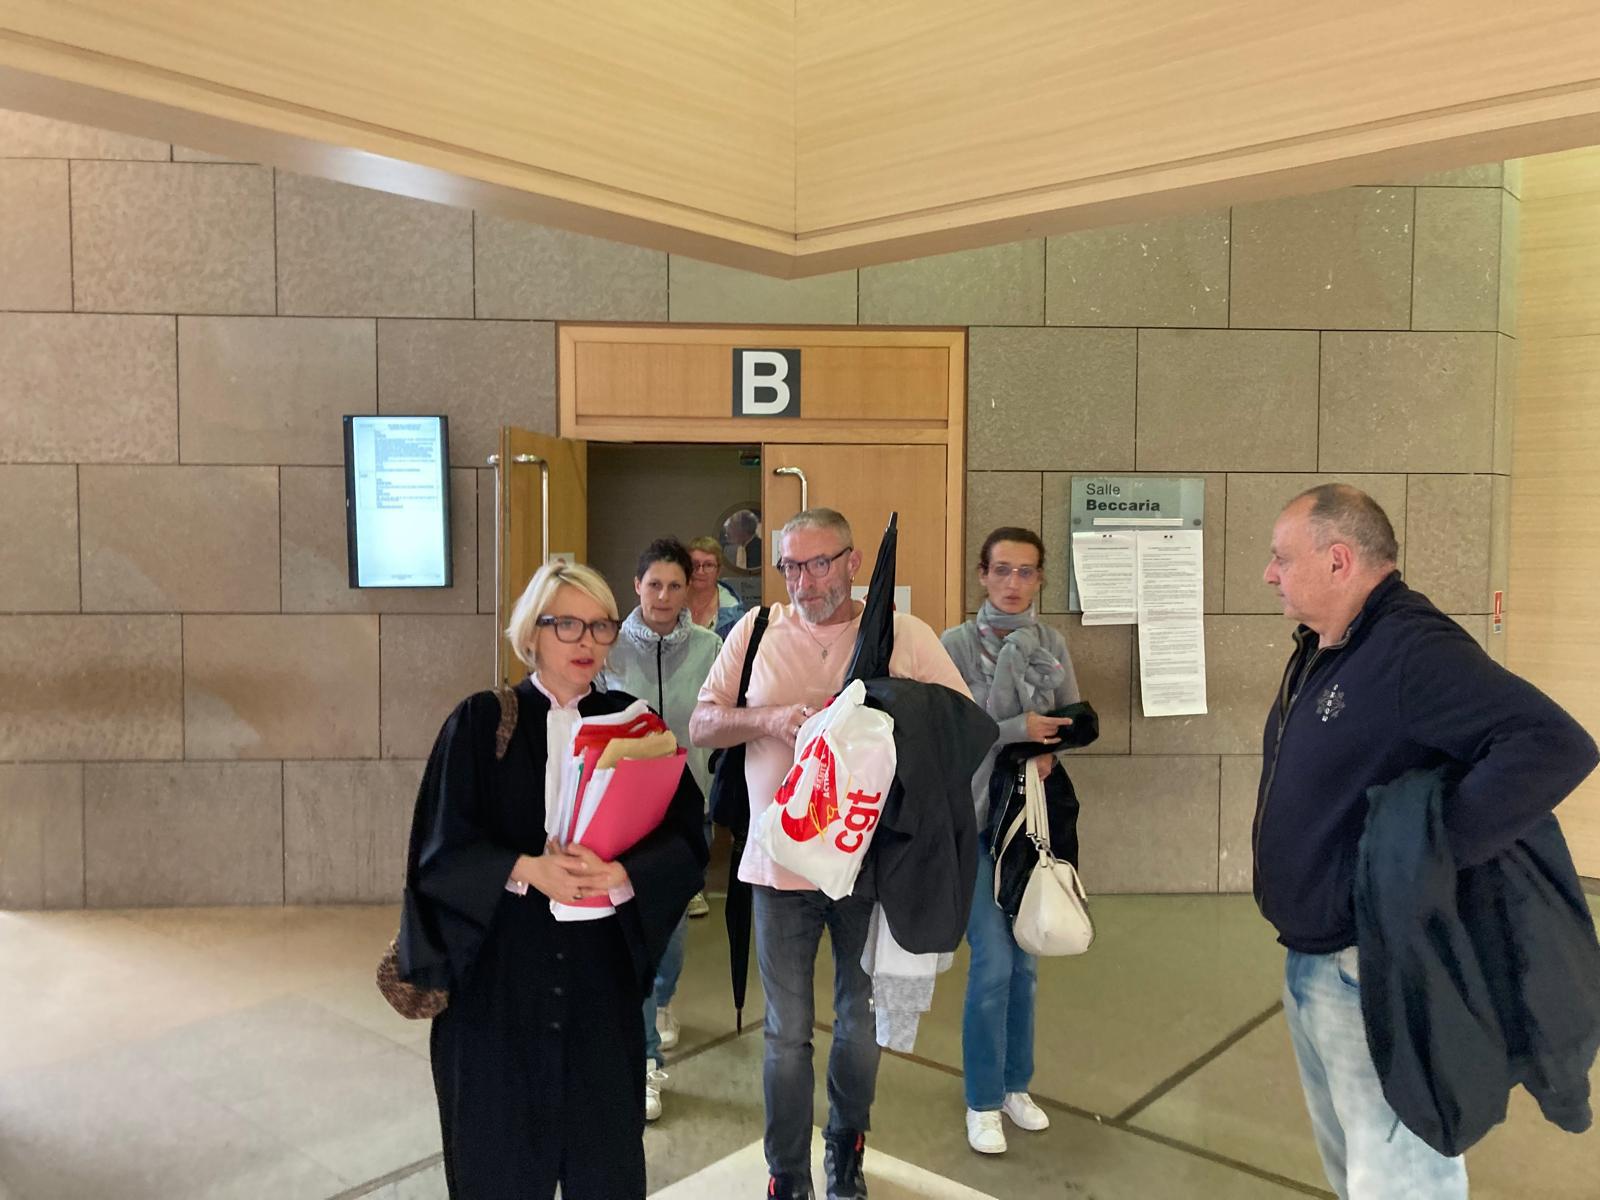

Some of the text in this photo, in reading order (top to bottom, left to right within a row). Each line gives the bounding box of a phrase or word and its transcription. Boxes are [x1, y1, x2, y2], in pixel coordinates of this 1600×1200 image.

[742, 351, 790, 415] B
[1086, 483, 1121, 496] Salle
[1086, 499, 1161, 512] Beccaria
[834, 789, 882, 854] cgt
